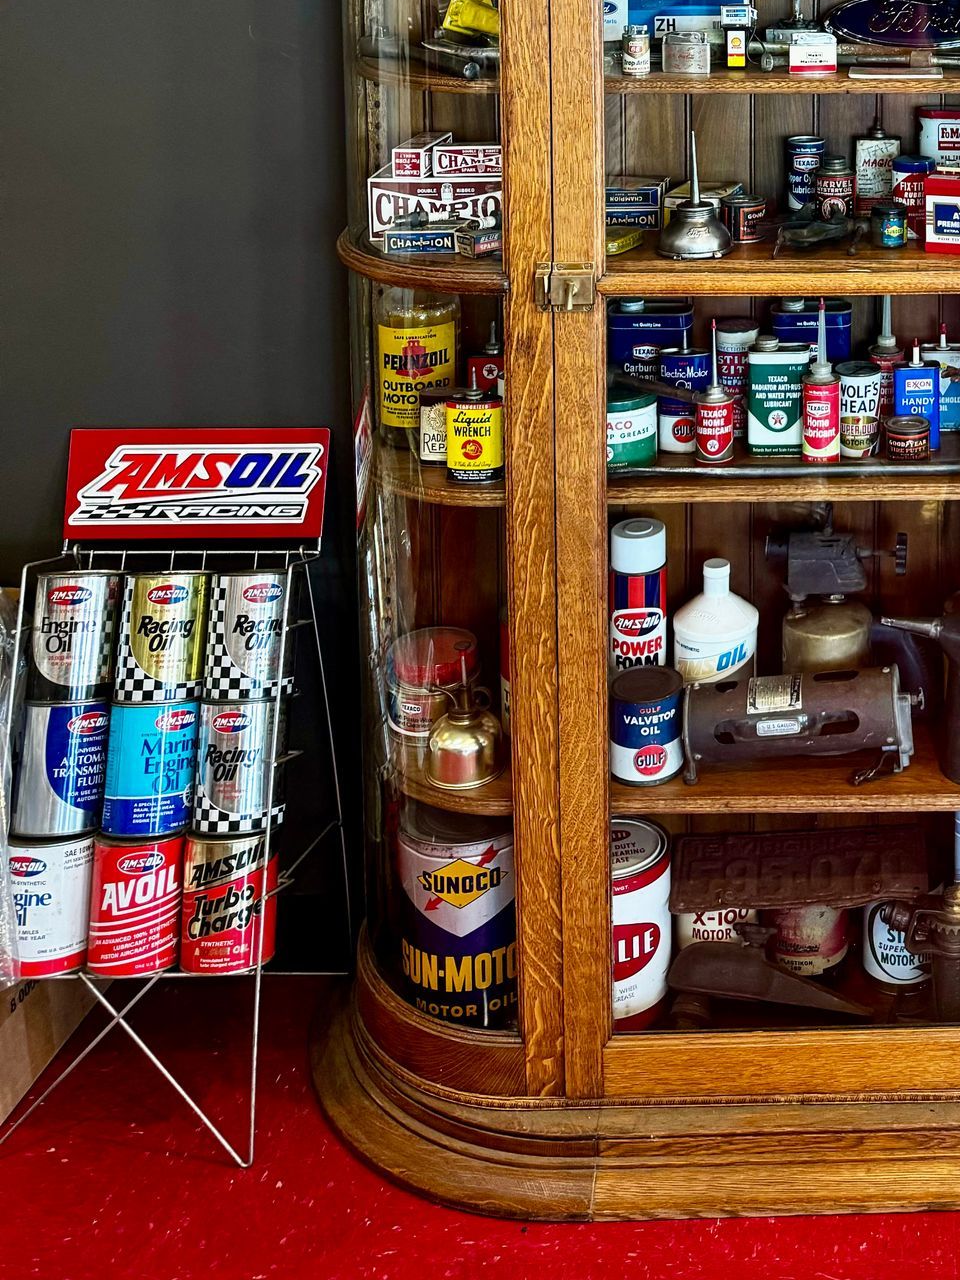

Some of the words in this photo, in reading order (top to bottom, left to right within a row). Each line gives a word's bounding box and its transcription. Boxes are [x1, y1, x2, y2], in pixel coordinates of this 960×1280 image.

[656, 17, 676, 32] ZH
[437, 153, 501, 170] CHAMPI
[794, 159, 819, 167] TEXACO
[862, 158, 893, 168] MAGIC
[816, 179, 853, 188] MARVEL
[390, 237, 452, 249] CHAMPION
[384, 348, 450, 371] PENNZOIL
[633, 348, 660, 356] TEXACO
[383, 377, 450, 392] OUTBOARD
[906, 380, 932, 390] EXXON
[763, 400, 793, 408] LUBRICANT
[807, 404, 830, 412] TEXACO
[840, 398, 877, 414] HEAD
[901, 397, 935, 406] HANDY
[700, 409, 728, 418] TEXACO
[910, 406, 927, 414] OIL
[453, 411, 492, 425] Liquid
[702, 418, 726, 427] HOME
[806, 417, 830, 428] Home
[453, 425, 491, 437] WRENCH
[888, 439, 927, 447] GOODYEAR
[95, 452, 312, 501] AMSOIL
[148, 503, 304, 522] RACING
[49, 589, 93, 603] AMSOIL
[149, 588, 189, 601] AMSOIL
[244, 587, 283, 599] AMSOIL
[40, 616, 97, 639] Engine
[136, 615, 196, 639] Racing
[232, 614, 283, 638] Racing
[615, 614, 662, 630] AMSOIL
[45, 634, 72, 654] Oil
[148, 633, 175, 653] Oil
[244, 632, 272, 652] Oil
[612, 635, 663, 657] POWER
[623, 709, 677, 726] VALVETOP
[639, 706, 662, 714] GULF
[70, 716, 109, 732] AMSOIL
[158, 713, 197, 728] AMSOIL
[213, 715, 252, 728] AMSOIL
[640, 727, 661, 736] OIL
[204, 743, 262, 769] Racing
[636, 752, 666, 769] GULF
[143, 755, 196, 777] Engine
[213, 763, 240, 782] Oil
[77, 774, 105, 787] FLUID
[154, 771, 181, 793] Oil
[64, 848, 78, 858] SAE
[614, 841, 637, 851] DUTY
[121, 855, 163, 870] AMSOIL
[190, 842, 265, 887] AMSOIL
[422, 866, 501, 895] SUNOCO
[100, 863, 179, 917] AVOIL
[192, 883, 255, 919] Turbo
[691, 927, 732, 941] MOTOR
[113, 938, 148, 951] LUBRICANT
[148, 933, 161, 943] FOR
[200, 940, 234, 948] SYNTHETIC
[232, 943, 250, 954] OIL
[878, 941, 905, 953] SUPER
[100, 952, 119, 960] PISTON
[120, 944, 149, 957] AIRCRAFT
[416, 996, 478, 1018] MOTOR
[488, 990, 518, 1012] OIL
